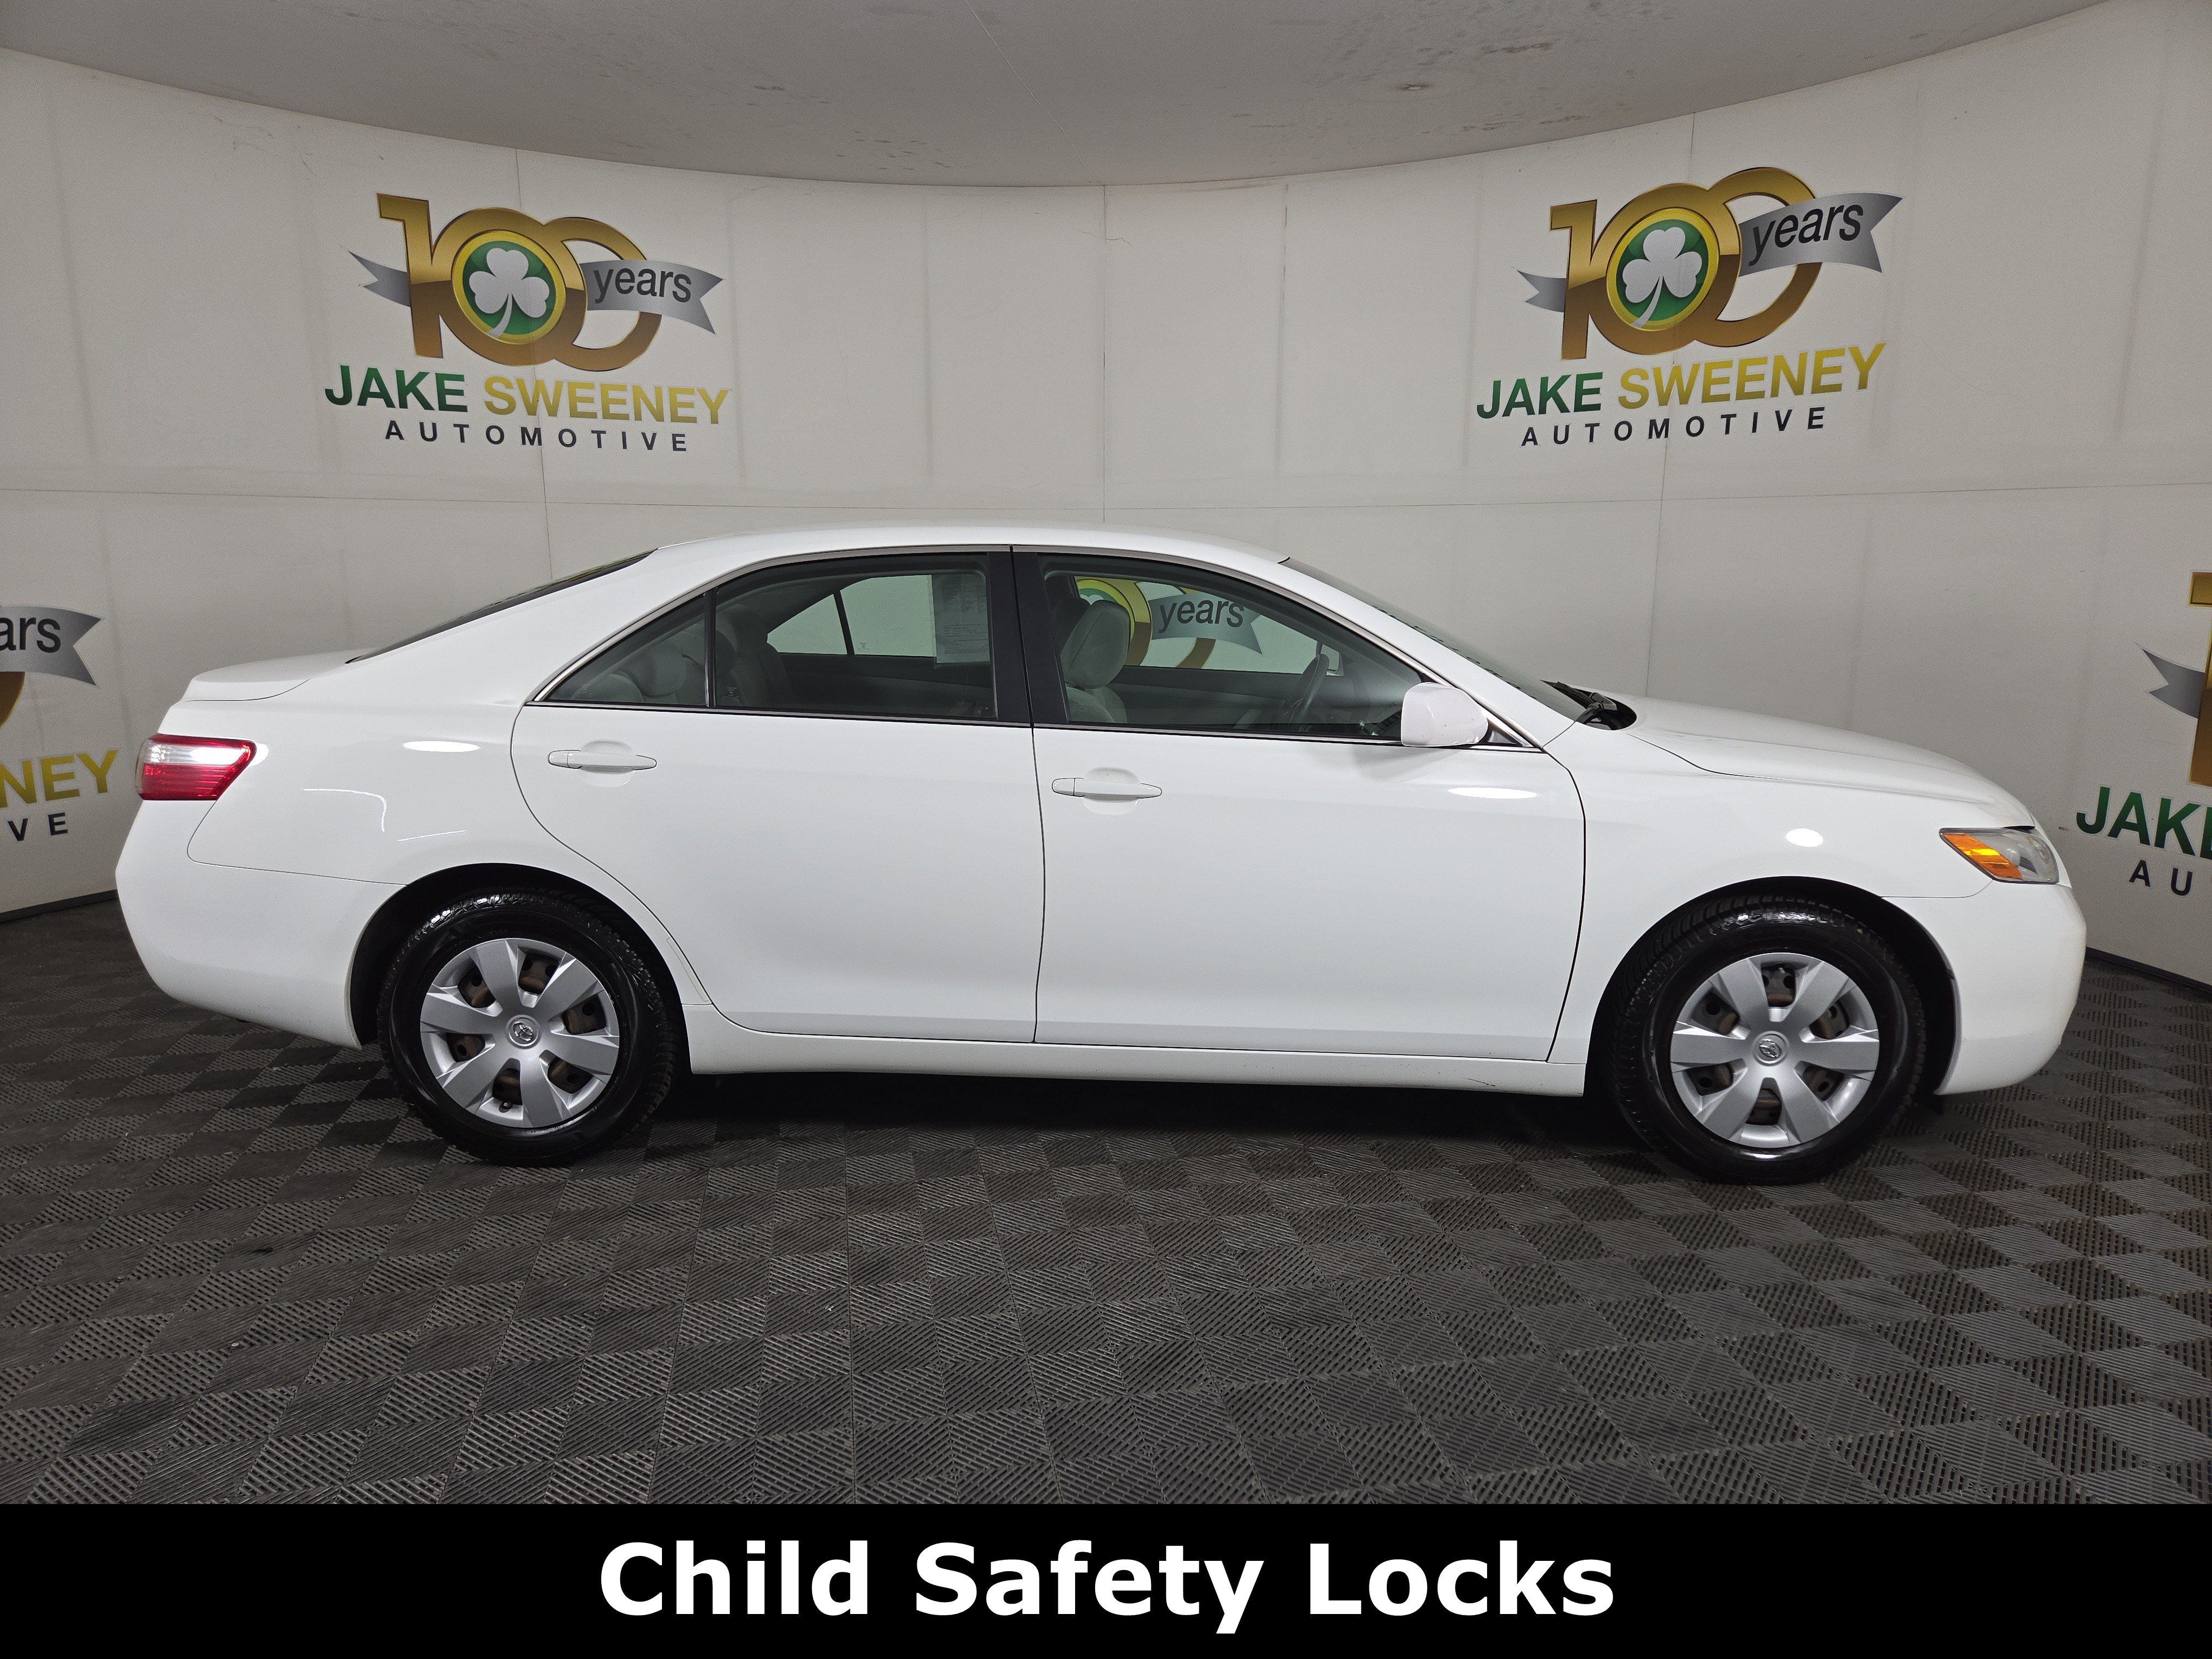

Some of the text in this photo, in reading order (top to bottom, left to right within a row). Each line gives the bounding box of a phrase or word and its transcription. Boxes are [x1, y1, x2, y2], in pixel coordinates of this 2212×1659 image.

[1748, 204, 1863, 267] years
[594, 267, 692, 304] years
[325, 364, 729, 425] JAKE SWEENEY
[1476, 343, 1888, 419] JAKE SWEENEY
[384, 420, 687, 452] AUTOMOTIVE
[1521, 407, 1825, 447] AUTOMOTIVE
[0, 617, 62, 654] ars
[1159, 600, 1245, 634] years
